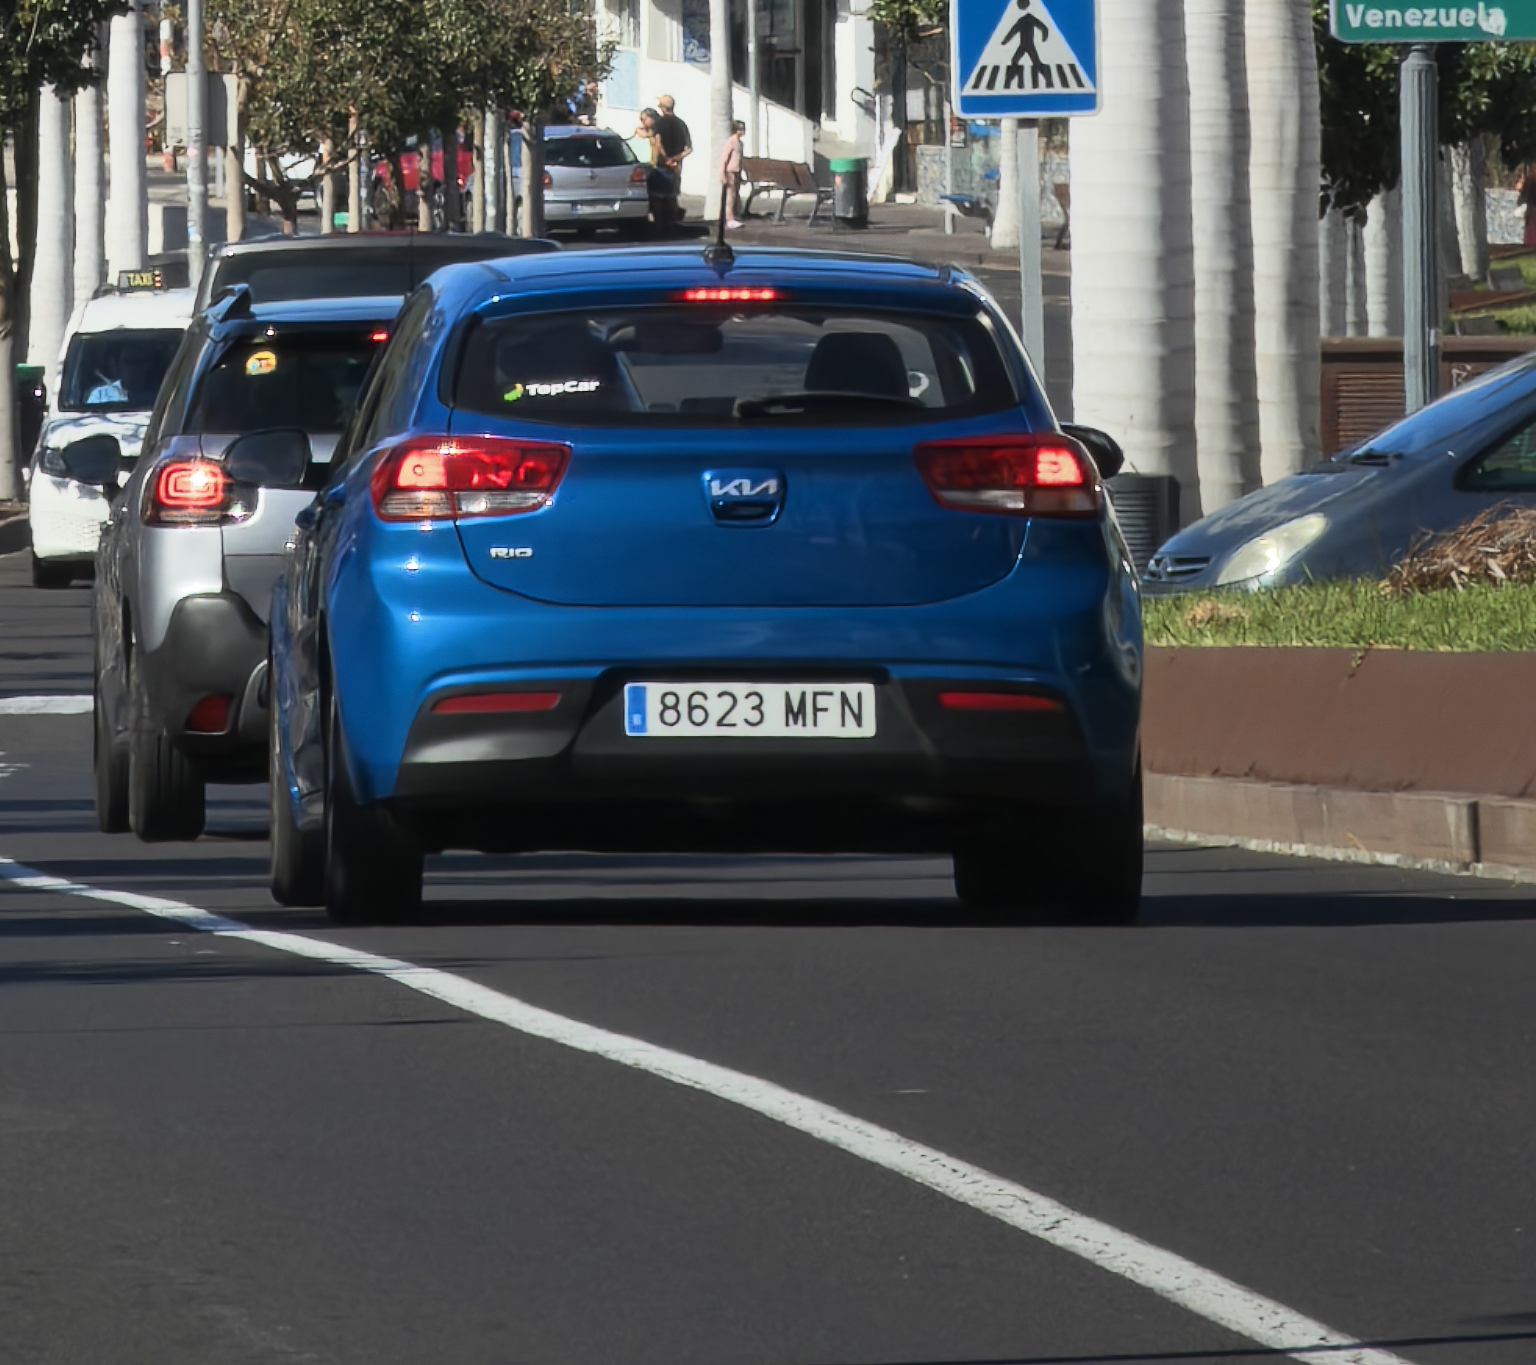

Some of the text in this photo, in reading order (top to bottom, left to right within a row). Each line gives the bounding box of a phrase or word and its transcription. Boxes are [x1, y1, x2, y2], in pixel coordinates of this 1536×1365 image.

[1345, 1, 1506, 31] Venezuela
[525, 380, 601, 396] TopCar
[710, 478, 778, 496] KIA
[489, 547, 533, 558] RIO
[658, 690, 864, 729] 8623 MFN
